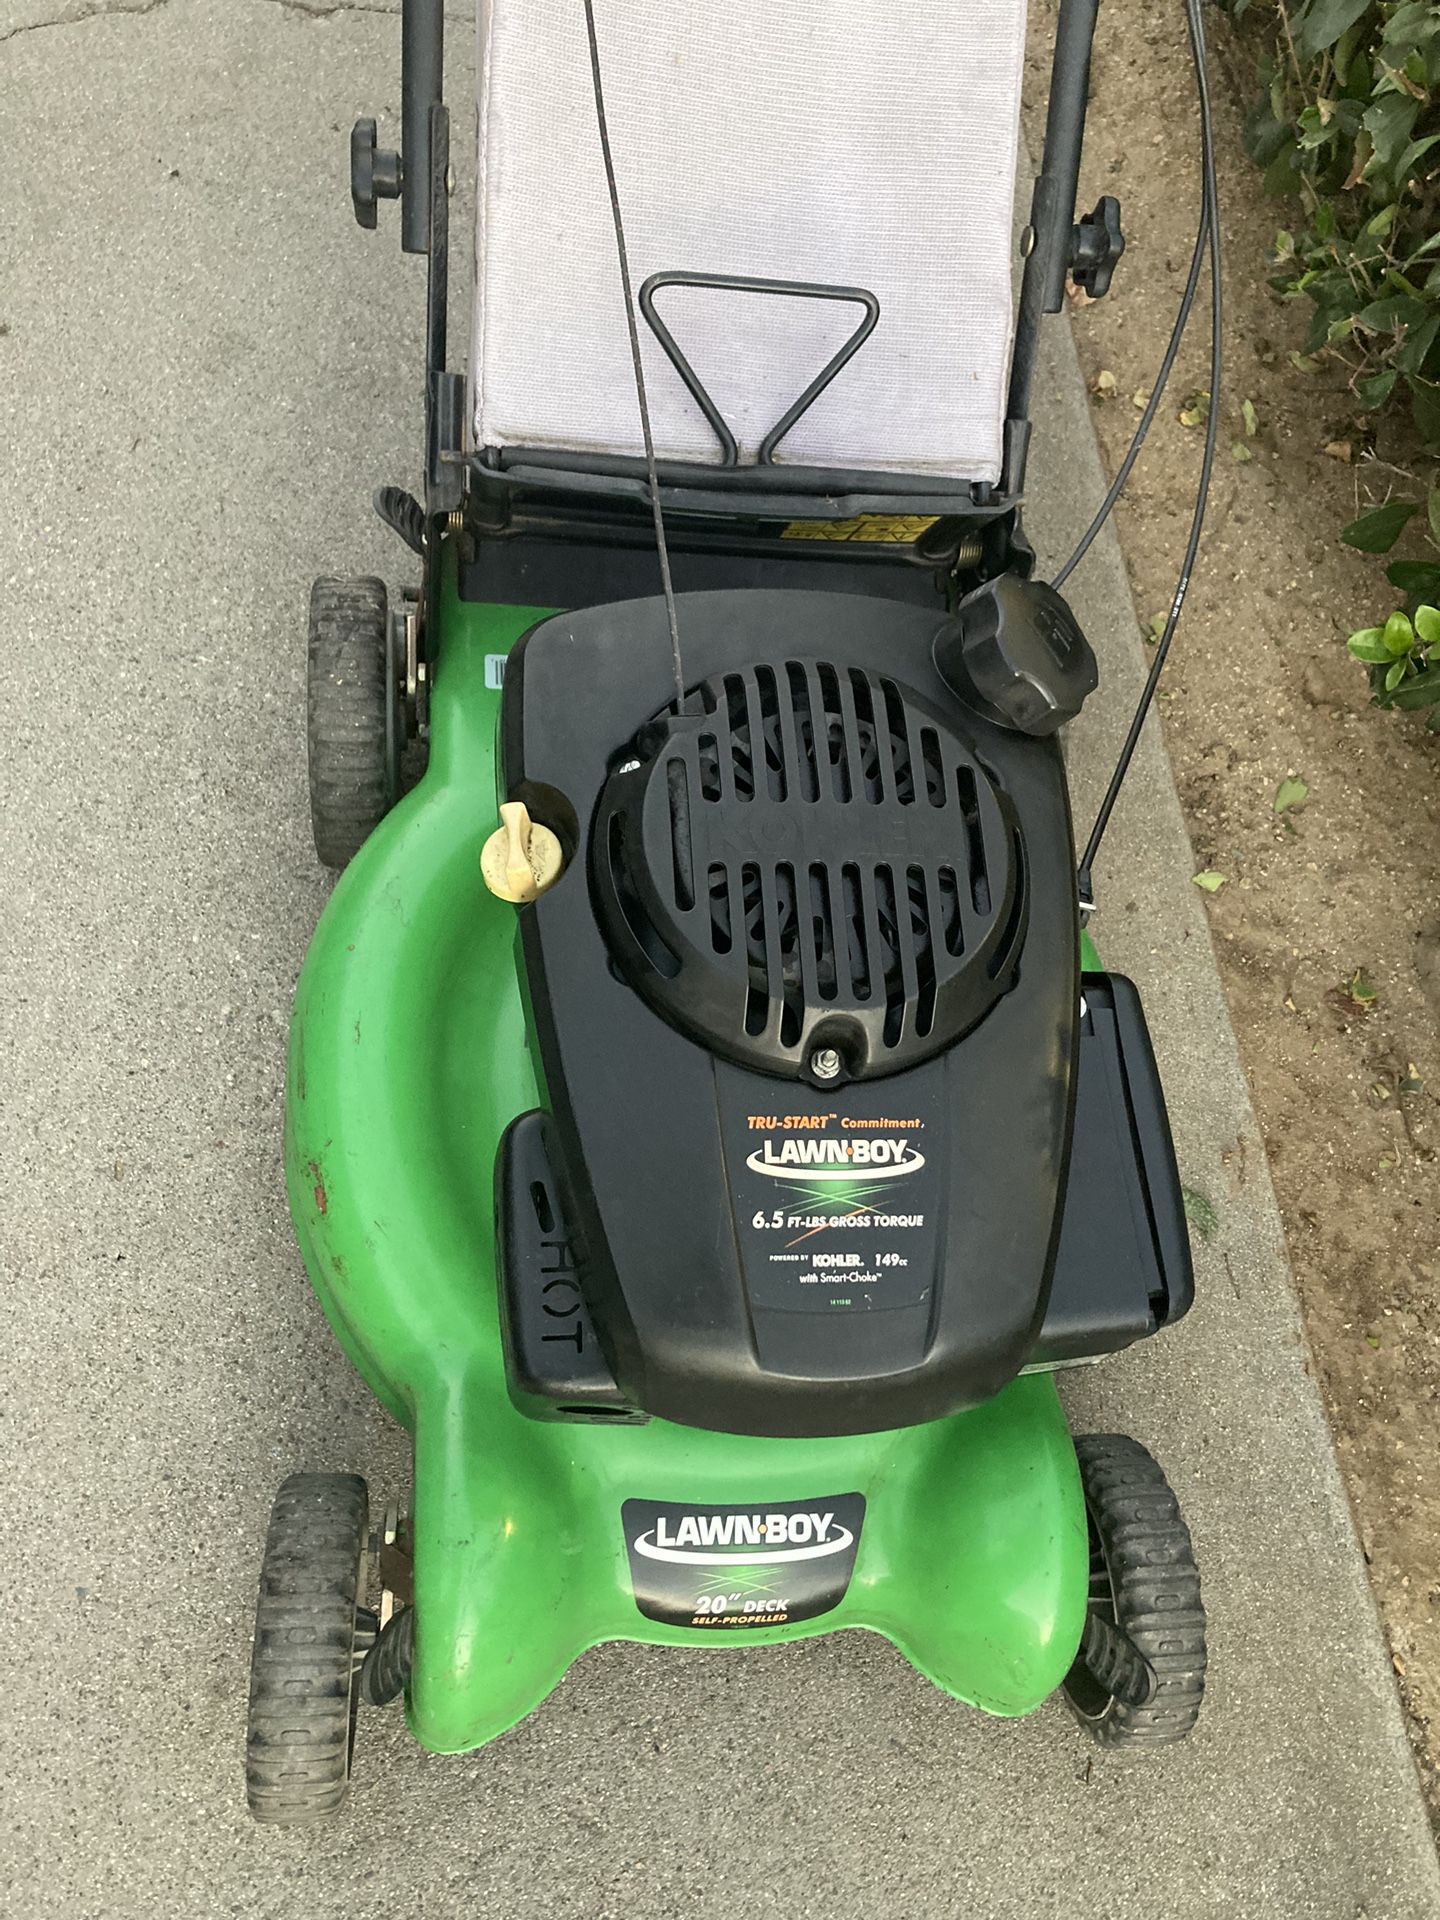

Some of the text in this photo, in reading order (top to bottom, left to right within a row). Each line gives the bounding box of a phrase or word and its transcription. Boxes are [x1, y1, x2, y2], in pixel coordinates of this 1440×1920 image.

[840, 1117, 920, 1129] Commitment
[752, 1211, 924, 1229] 6.5 FT-LBS GROSS TORQUE
[875, 1253, 908, 1267] 149cc
[799, 1272, 818, 1283] with
[541, 1241, 582, 1353] HOT
[743, 1599, 790, 1613] DECK
[691, 1613, 787, 1625] SELF-PROPELLED
